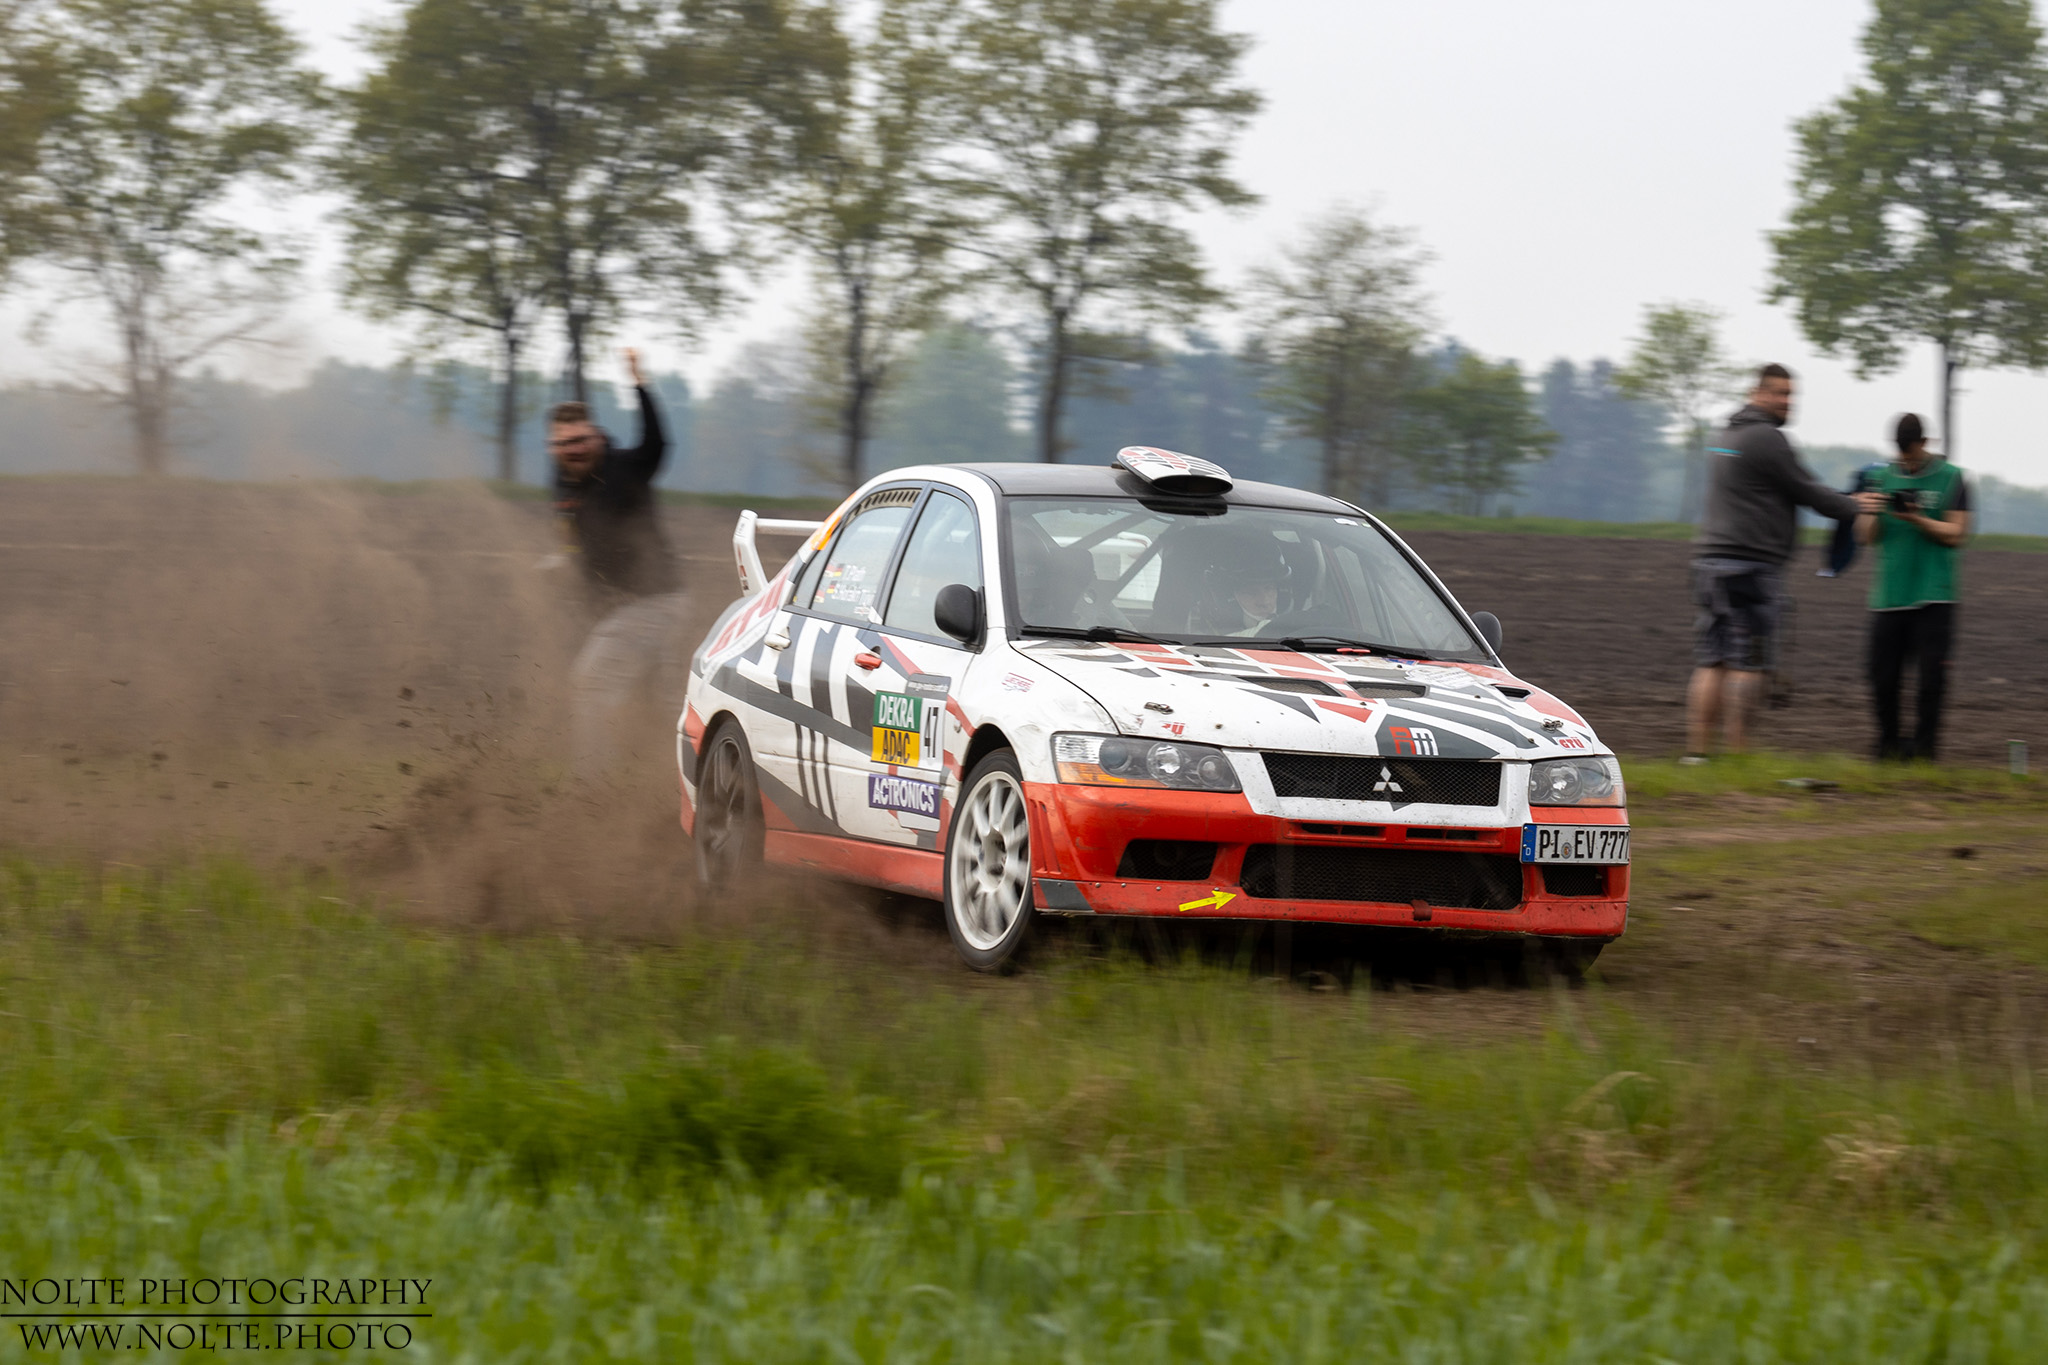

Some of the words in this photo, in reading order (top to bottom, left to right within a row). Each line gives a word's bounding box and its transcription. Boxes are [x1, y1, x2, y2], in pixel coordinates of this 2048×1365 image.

[878, 694, 915, 729] DEKRA
[880, 729, 911, 765] ADAC
[924, 706, 939, 758] 47
[1559, 736, 1585, 749] GTÜ
[872, 777, 935, 814] ACTRONICS
[1539, 829, 1560, 859] PI
